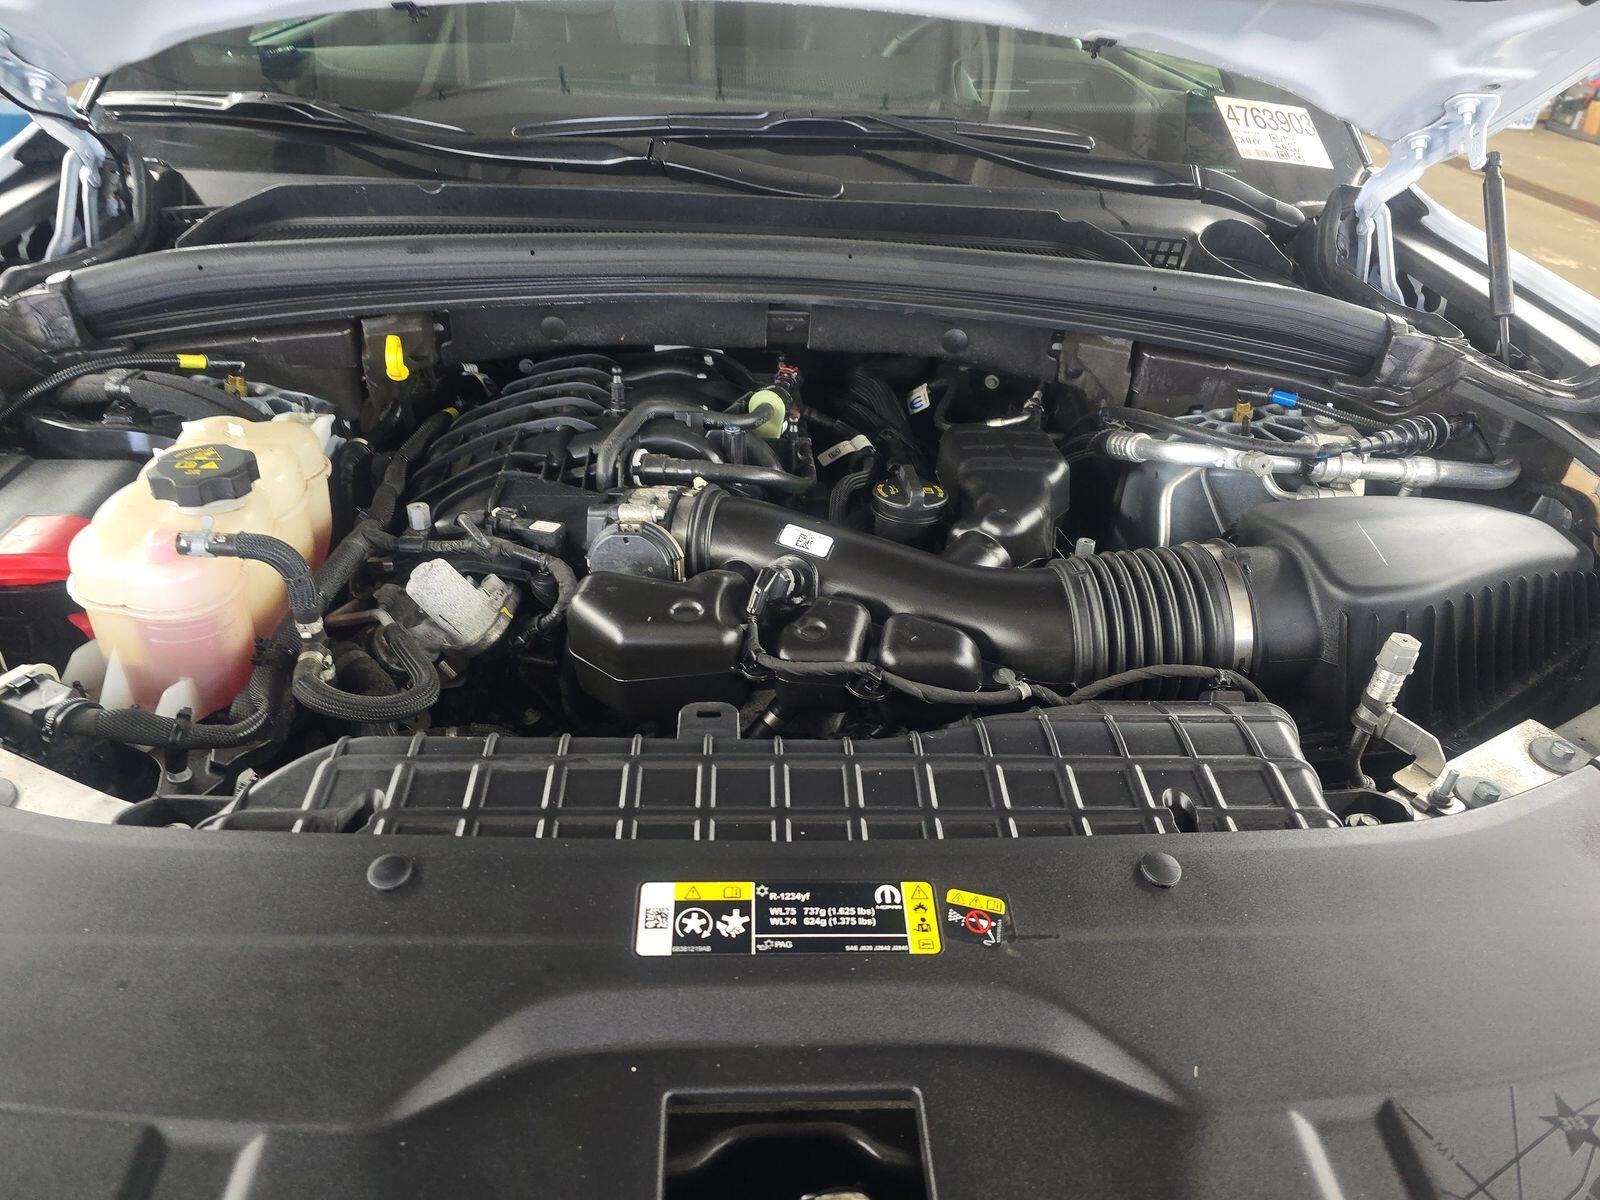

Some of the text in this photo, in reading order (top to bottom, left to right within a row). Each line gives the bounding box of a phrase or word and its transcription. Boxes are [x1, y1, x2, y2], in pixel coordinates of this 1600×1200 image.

[1227, 104, 1316, 137] 4763903
[769, 892, 811, 902] R-1234yf
[769, 906, 876, 917] WL75 737g (1.625 lbs)
[769, 917, 877, 927] WL74 624g (1.375 lbs)
[774, 940, 794, 949] PAG
